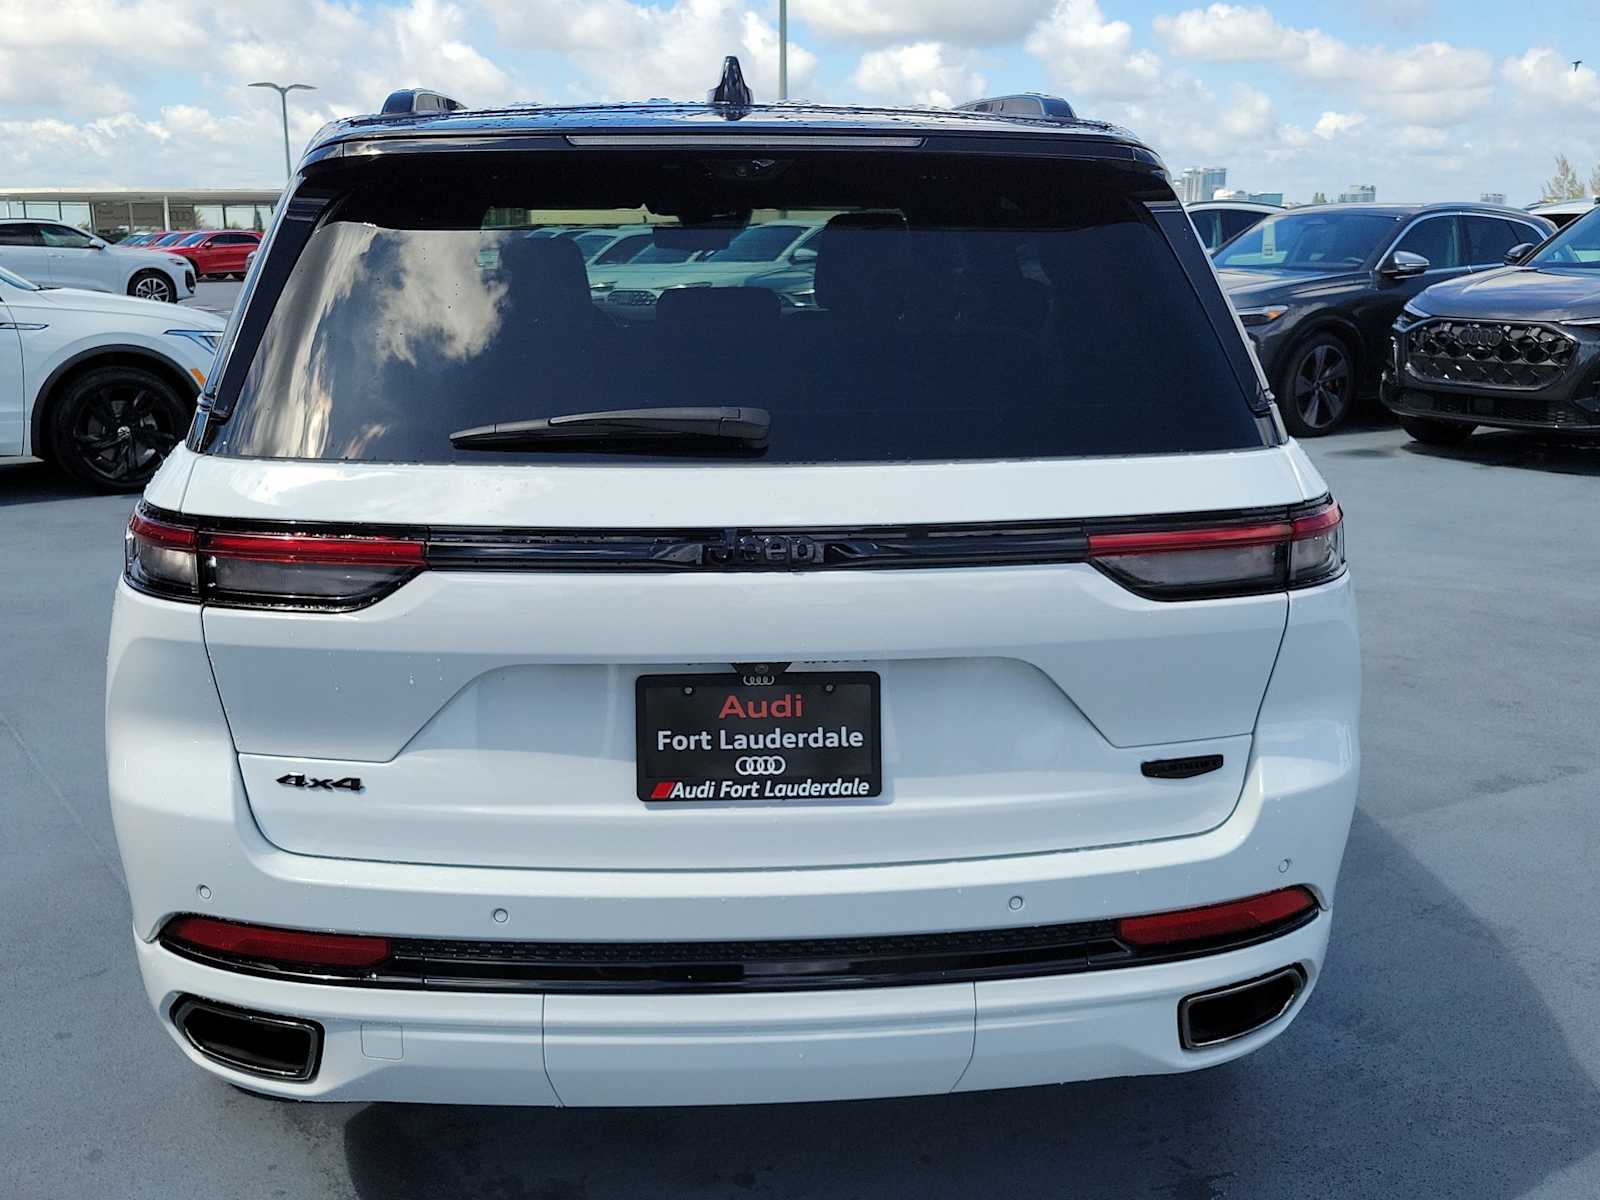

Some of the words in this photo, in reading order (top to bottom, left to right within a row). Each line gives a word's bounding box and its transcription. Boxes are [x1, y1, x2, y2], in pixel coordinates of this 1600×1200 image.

[709, 528, 816, 568] Jeep
[719, 694, 804, 719] Audi
[657, 729, 712, 751] Fort
[720, 727, 864, 750] Lauderdale
[276, 773, 365, 791] 4x4
[670, 781, 716, 799] Audi
[720, 780, 760, 798] Fort
[765, 778, 870, 797] Lauderdale
